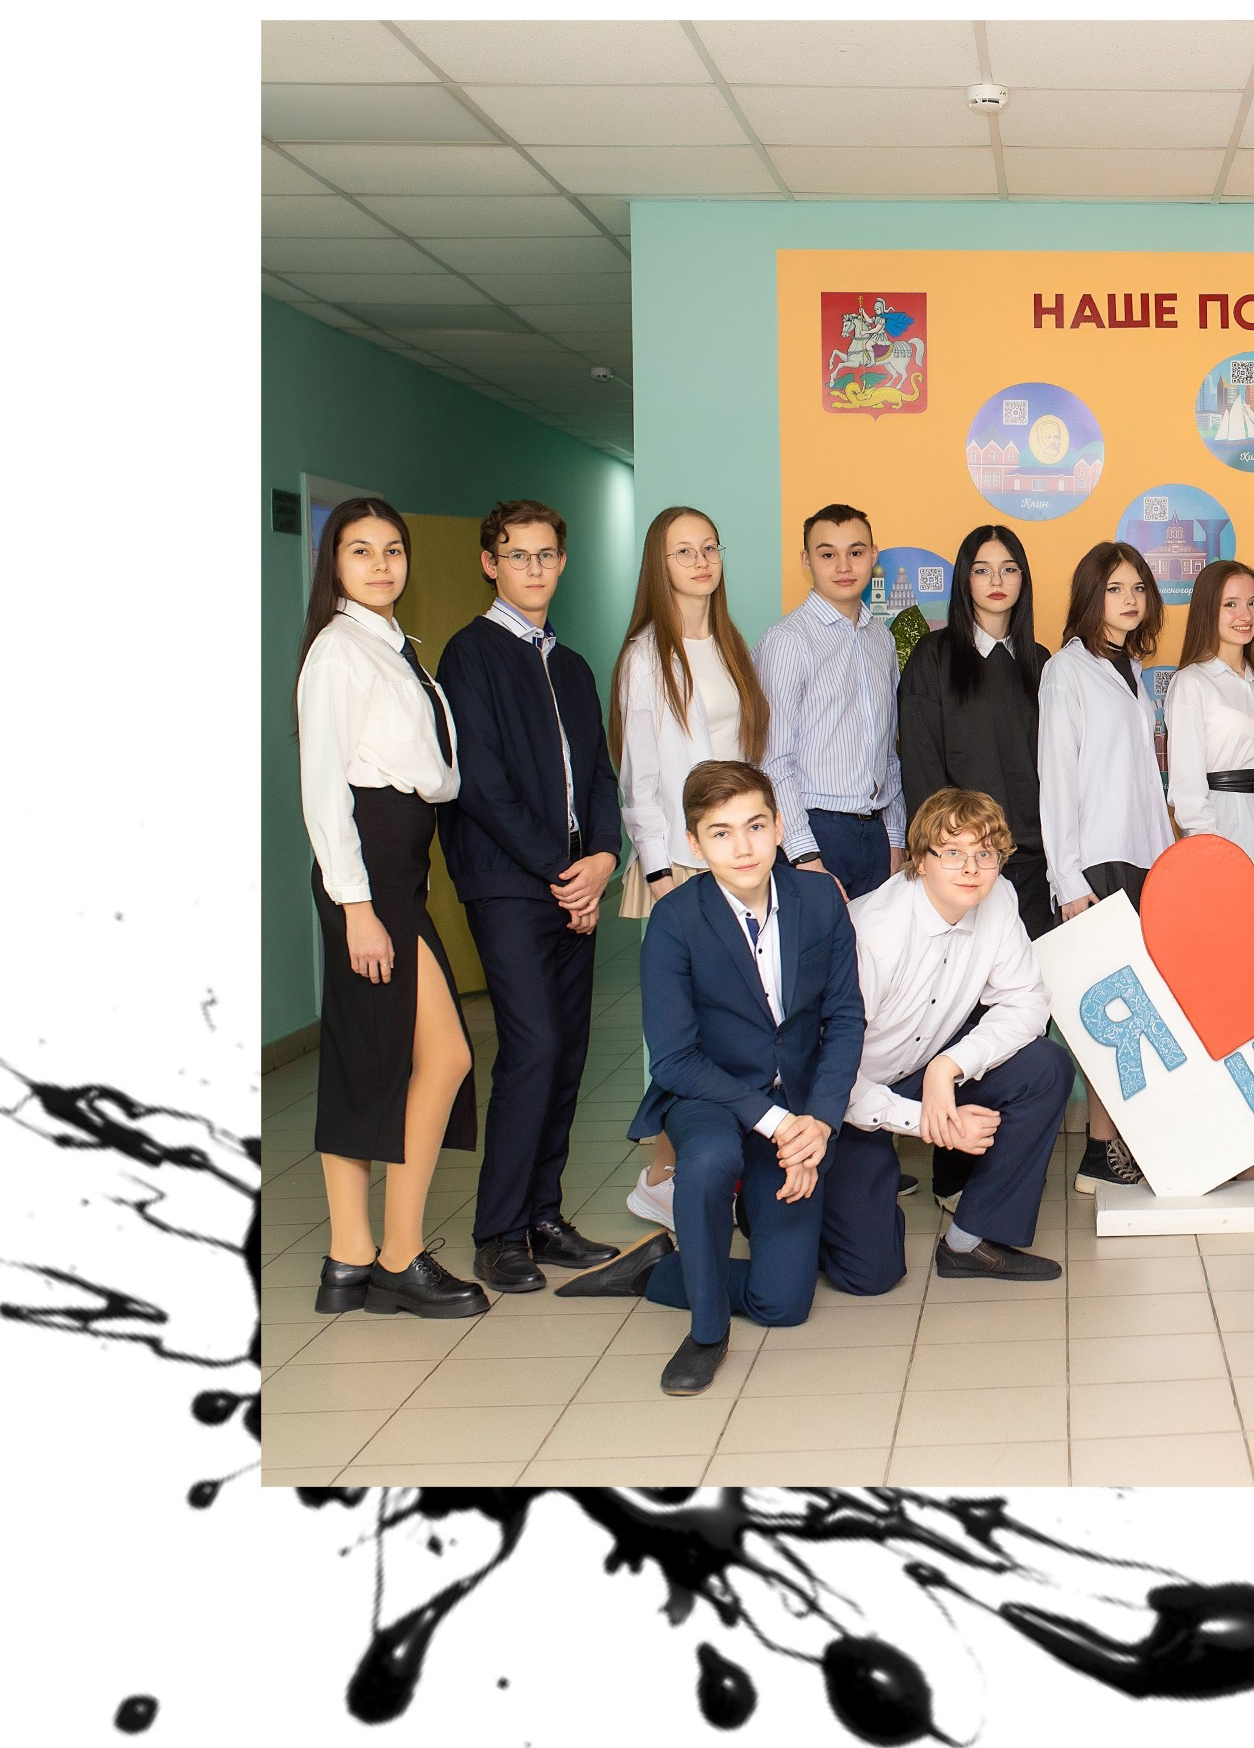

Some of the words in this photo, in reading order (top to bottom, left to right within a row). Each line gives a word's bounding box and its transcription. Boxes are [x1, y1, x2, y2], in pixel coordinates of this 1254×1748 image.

[1033, 293, 1179, 330] НАШЕ
[1020, 497, 1050, 509] Клин
[1079, 964, 1188, 1101] Я
